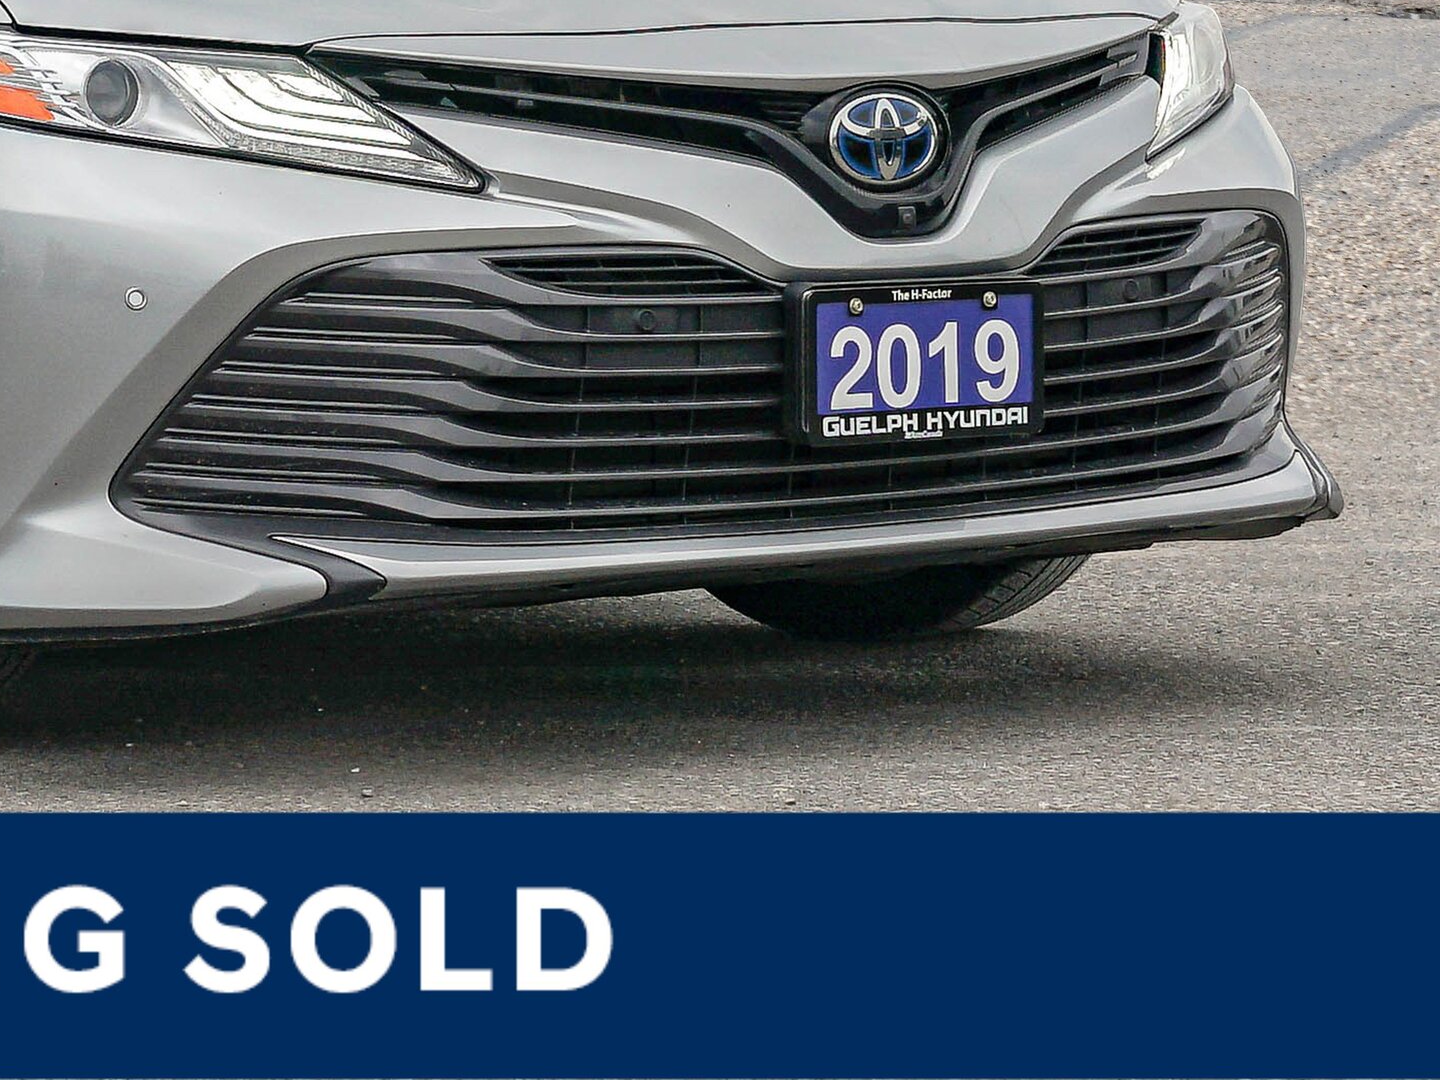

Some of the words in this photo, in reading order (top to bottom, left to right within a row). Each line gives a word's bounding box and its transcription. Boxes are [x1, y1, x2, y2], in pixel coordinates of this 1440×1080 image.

[892, 290, 910, 301] The
[911, 289, 952, 300] H-Factor
[830, 319, 1021, 411] 2019
[822, 416, 919, 438] GUELPH
[926, 406, 1028, 432] HYUNDAI
